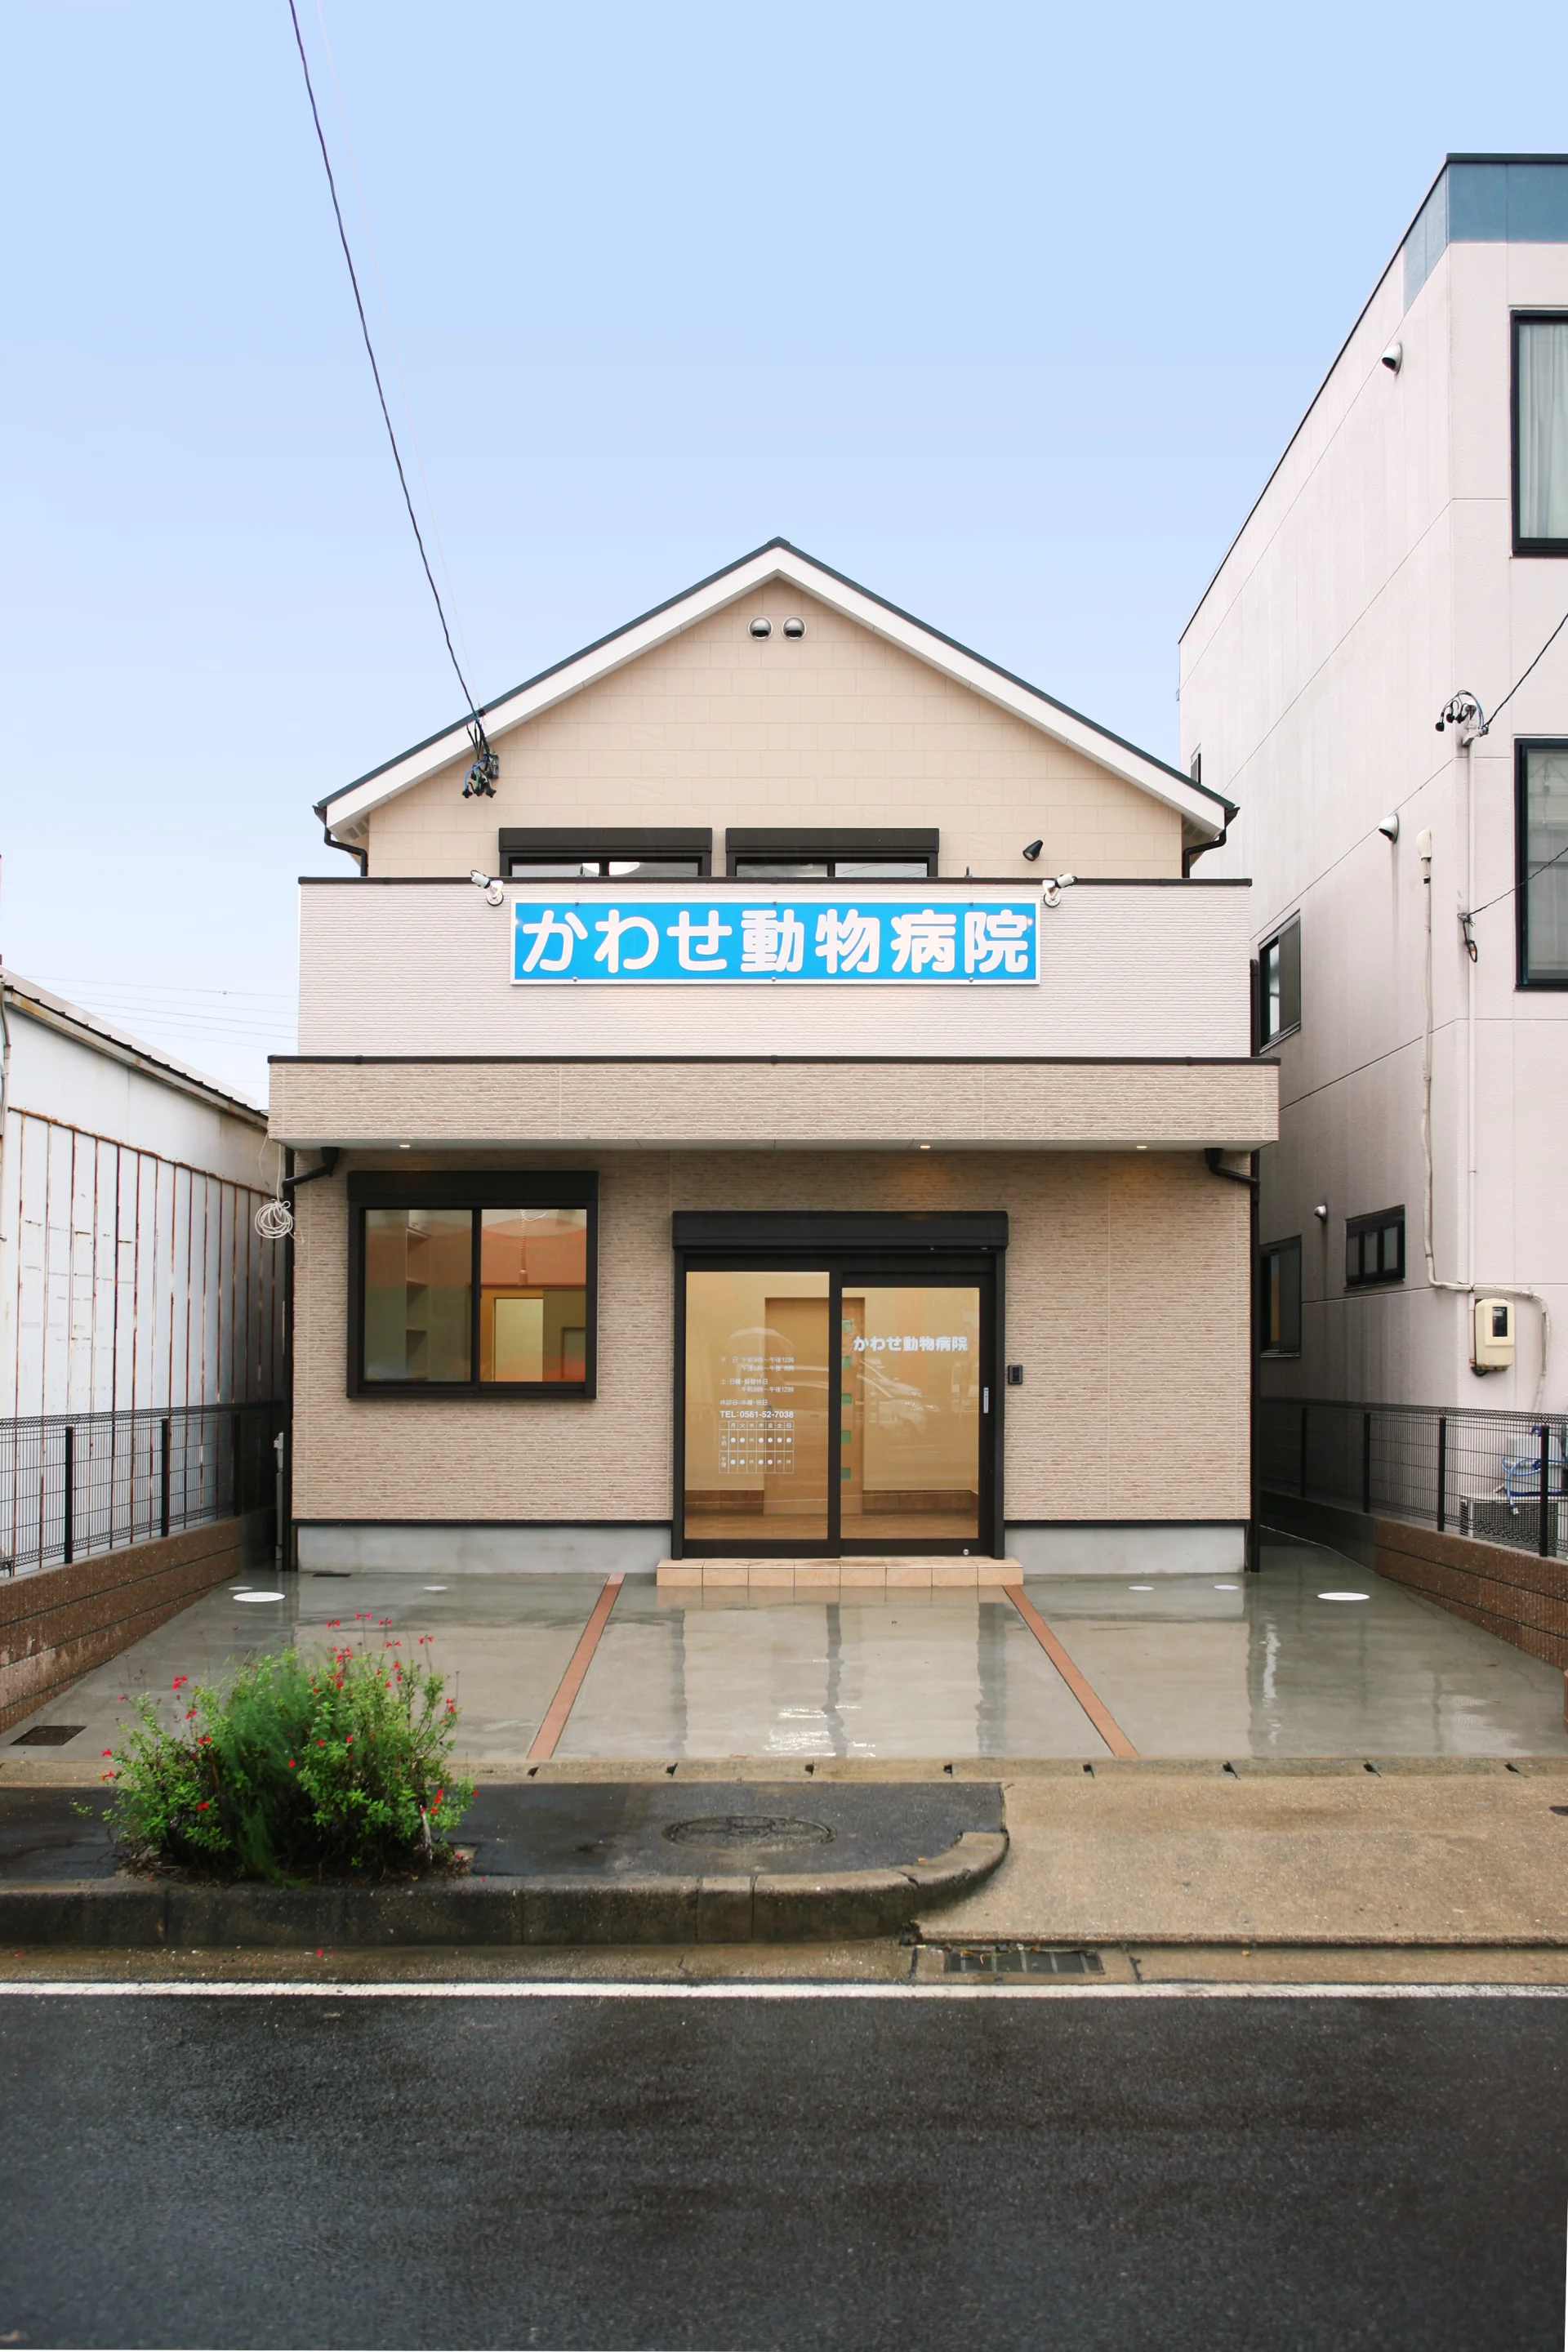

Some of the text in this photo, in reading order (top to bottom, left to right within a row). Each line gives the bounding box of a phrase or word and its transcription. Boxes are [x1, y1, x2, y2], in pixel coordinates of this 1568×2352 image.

[522, 908, 1029, 973] かわせ動物病院
[853, 1336, 969, 1352] かわせ動物病院
[719, 1410, 795, 1419] TEL:0561-52-7038
